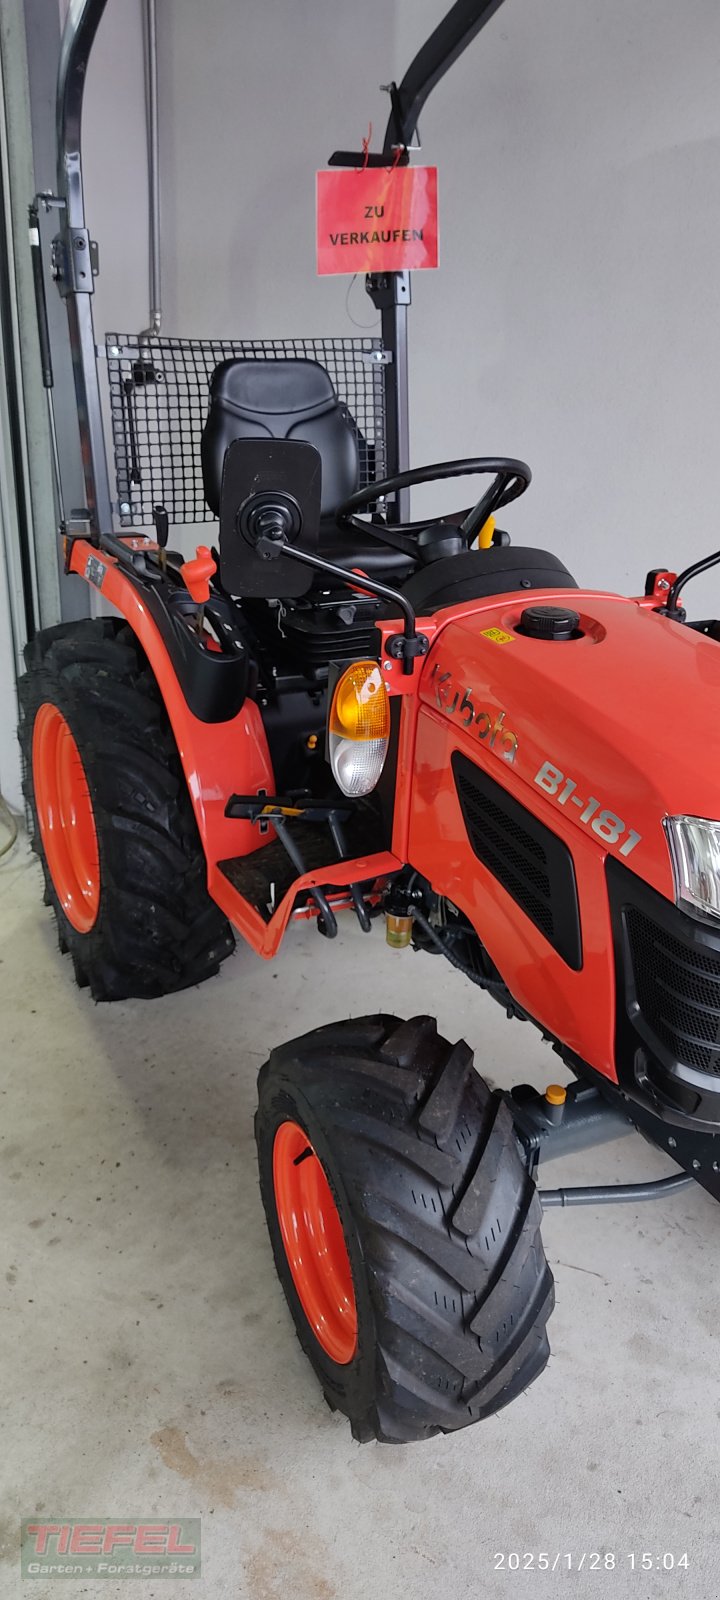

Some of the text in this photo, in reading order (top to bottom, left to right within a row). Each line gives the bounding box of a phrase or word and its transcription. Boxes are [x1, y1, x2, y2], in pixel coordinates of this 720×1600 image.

[364, 206, 384, 218] ZU
[329, 229, 423, 246] VERKAUFEN
[430, 664, 642, 857] Kubota B1-181
